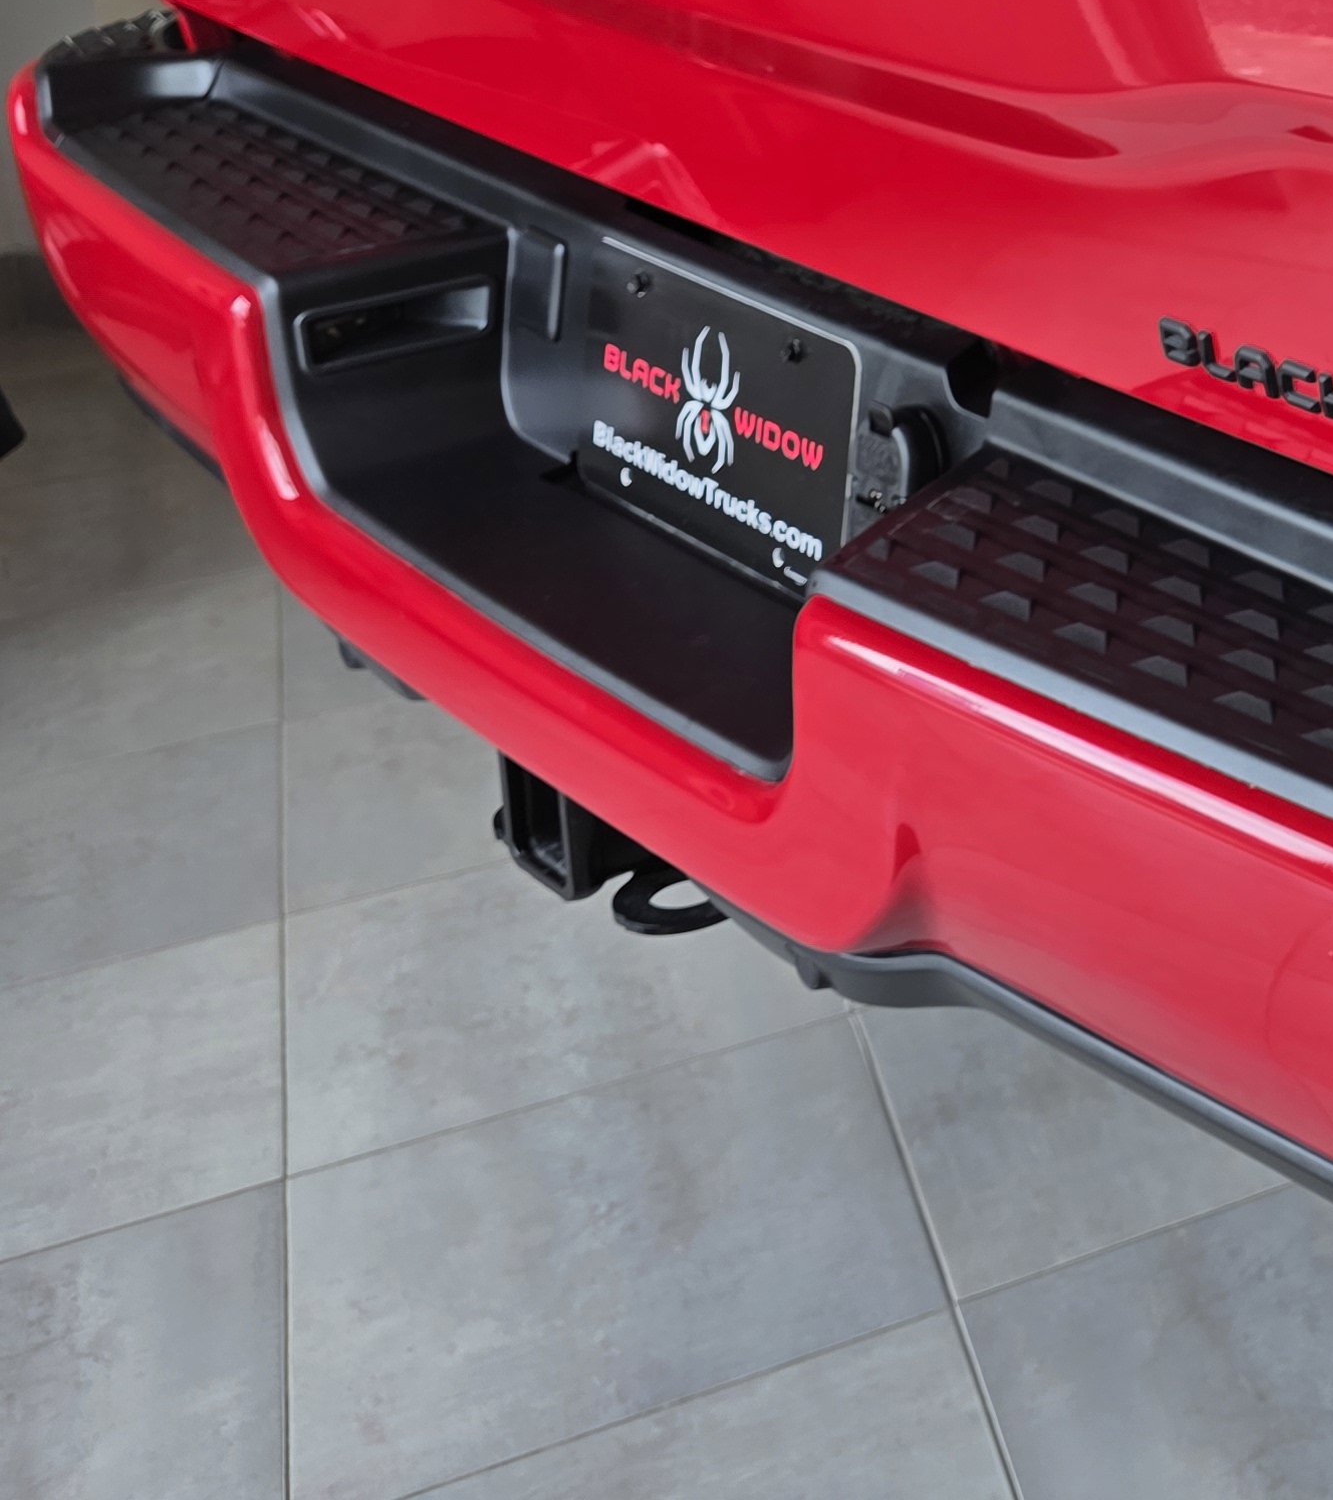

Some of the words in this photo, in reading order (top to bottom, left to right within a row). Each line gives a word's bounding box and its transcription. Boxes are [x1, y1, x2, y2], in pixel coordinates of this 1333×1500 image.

[603, 343, 682, 404] BLACK
[734, 406, 824, 471] WIDOW
[592, 420, 823, 562] BlackWidowTrucks.com
